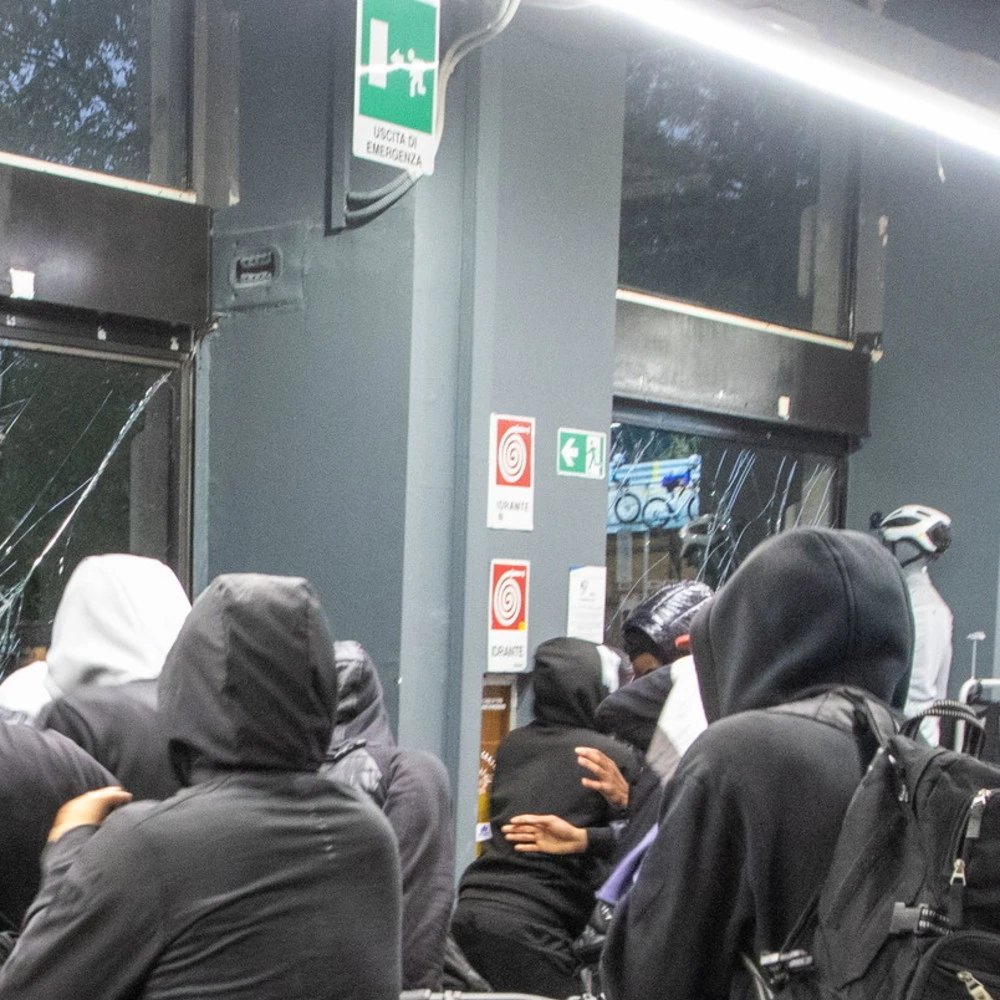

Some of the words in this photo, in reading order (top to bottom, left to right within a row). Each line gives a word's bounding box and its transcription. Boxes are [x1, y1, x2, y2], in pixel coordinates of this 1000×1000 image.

[374, 126, 405, 144] USCITA
[408, 135, 418, 149] DI
[366, 141, 422, 166] EMERGENZA
